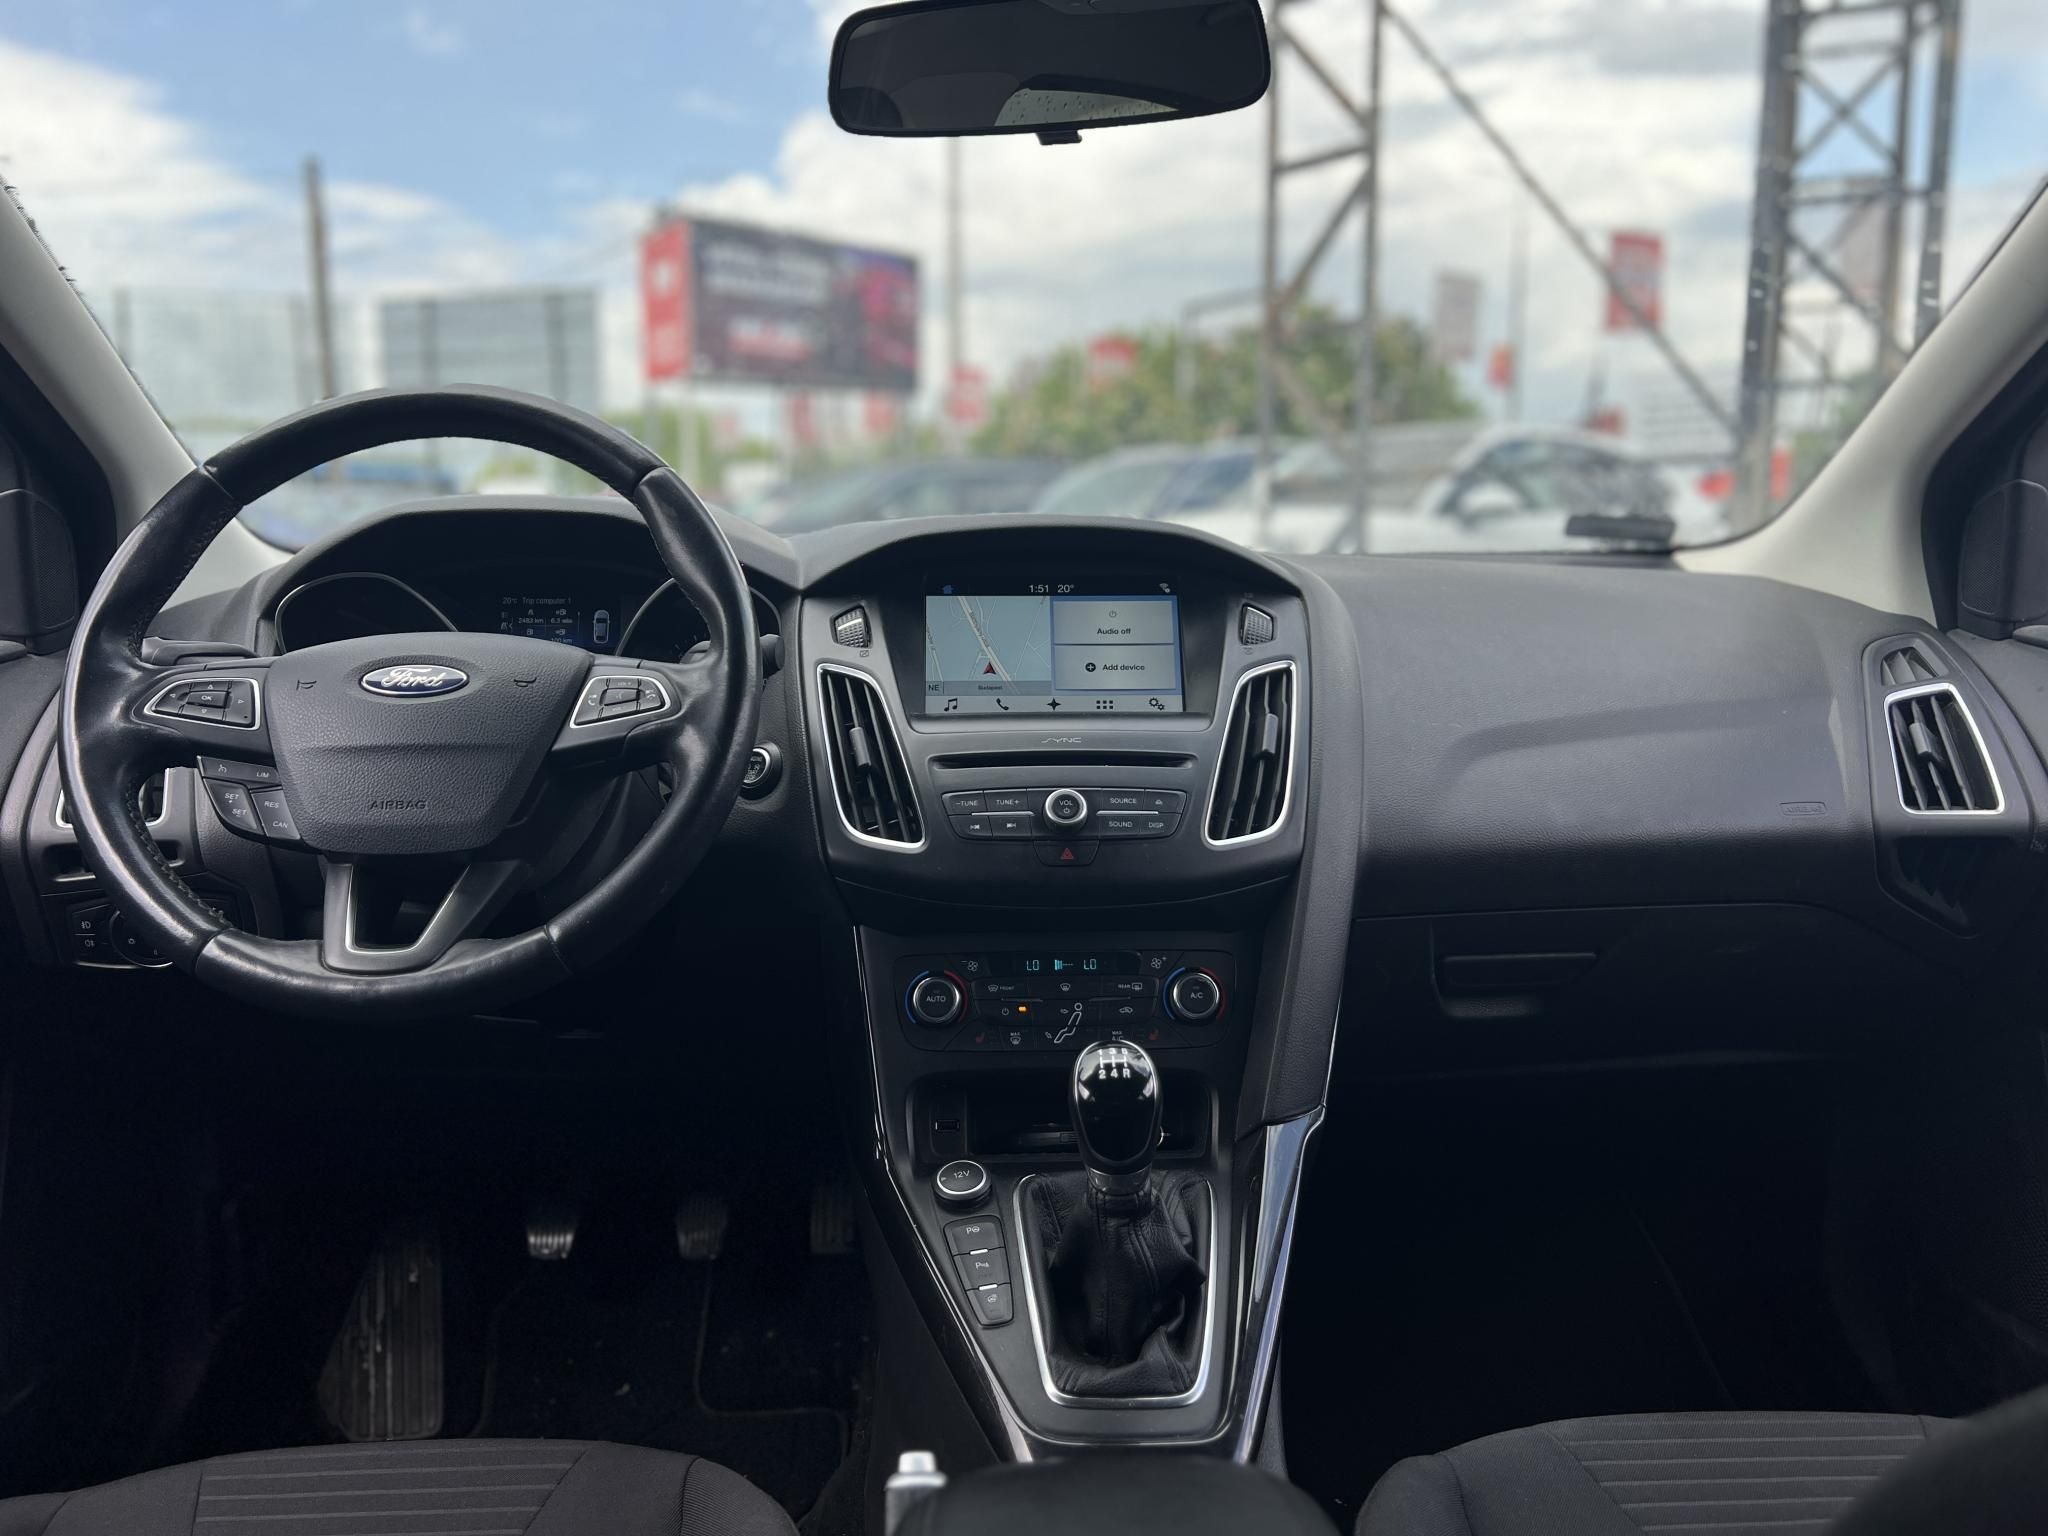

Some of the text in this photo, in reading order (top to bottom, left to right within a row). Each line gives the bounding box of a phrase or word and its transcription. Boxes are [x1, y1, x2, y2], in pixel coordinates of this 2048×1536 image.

[1028, 584, 1075, 593] 1:51 20°
[522, 597, 534, 605] Trip
[1096, 627, 1132, 635] Audio off
[1102, 663, 1146, 671] Add device
[380, 667, 447, 688] Ford
[928, 684, 940, 692] NE
[256, 771, 270, 779] LIM
[224, 792, 240, 800] SET
[263, 800, 280, 809] RES
[368, 800, 428, 811] AIRBAG
[231, 808, 248, 816] SET
[272, 820, 289, 829] CAN
[1108, 820, 1133, 828] SOUND
[1148, 821, 1164, 829] DISP
[925, 995, 947, 1003] AUTO
[1190, 991, 1204, 999] A/C
[1098, 1068, 1131, 1080] 2 4 R
[954, 1170, 970, 1178] 12V
